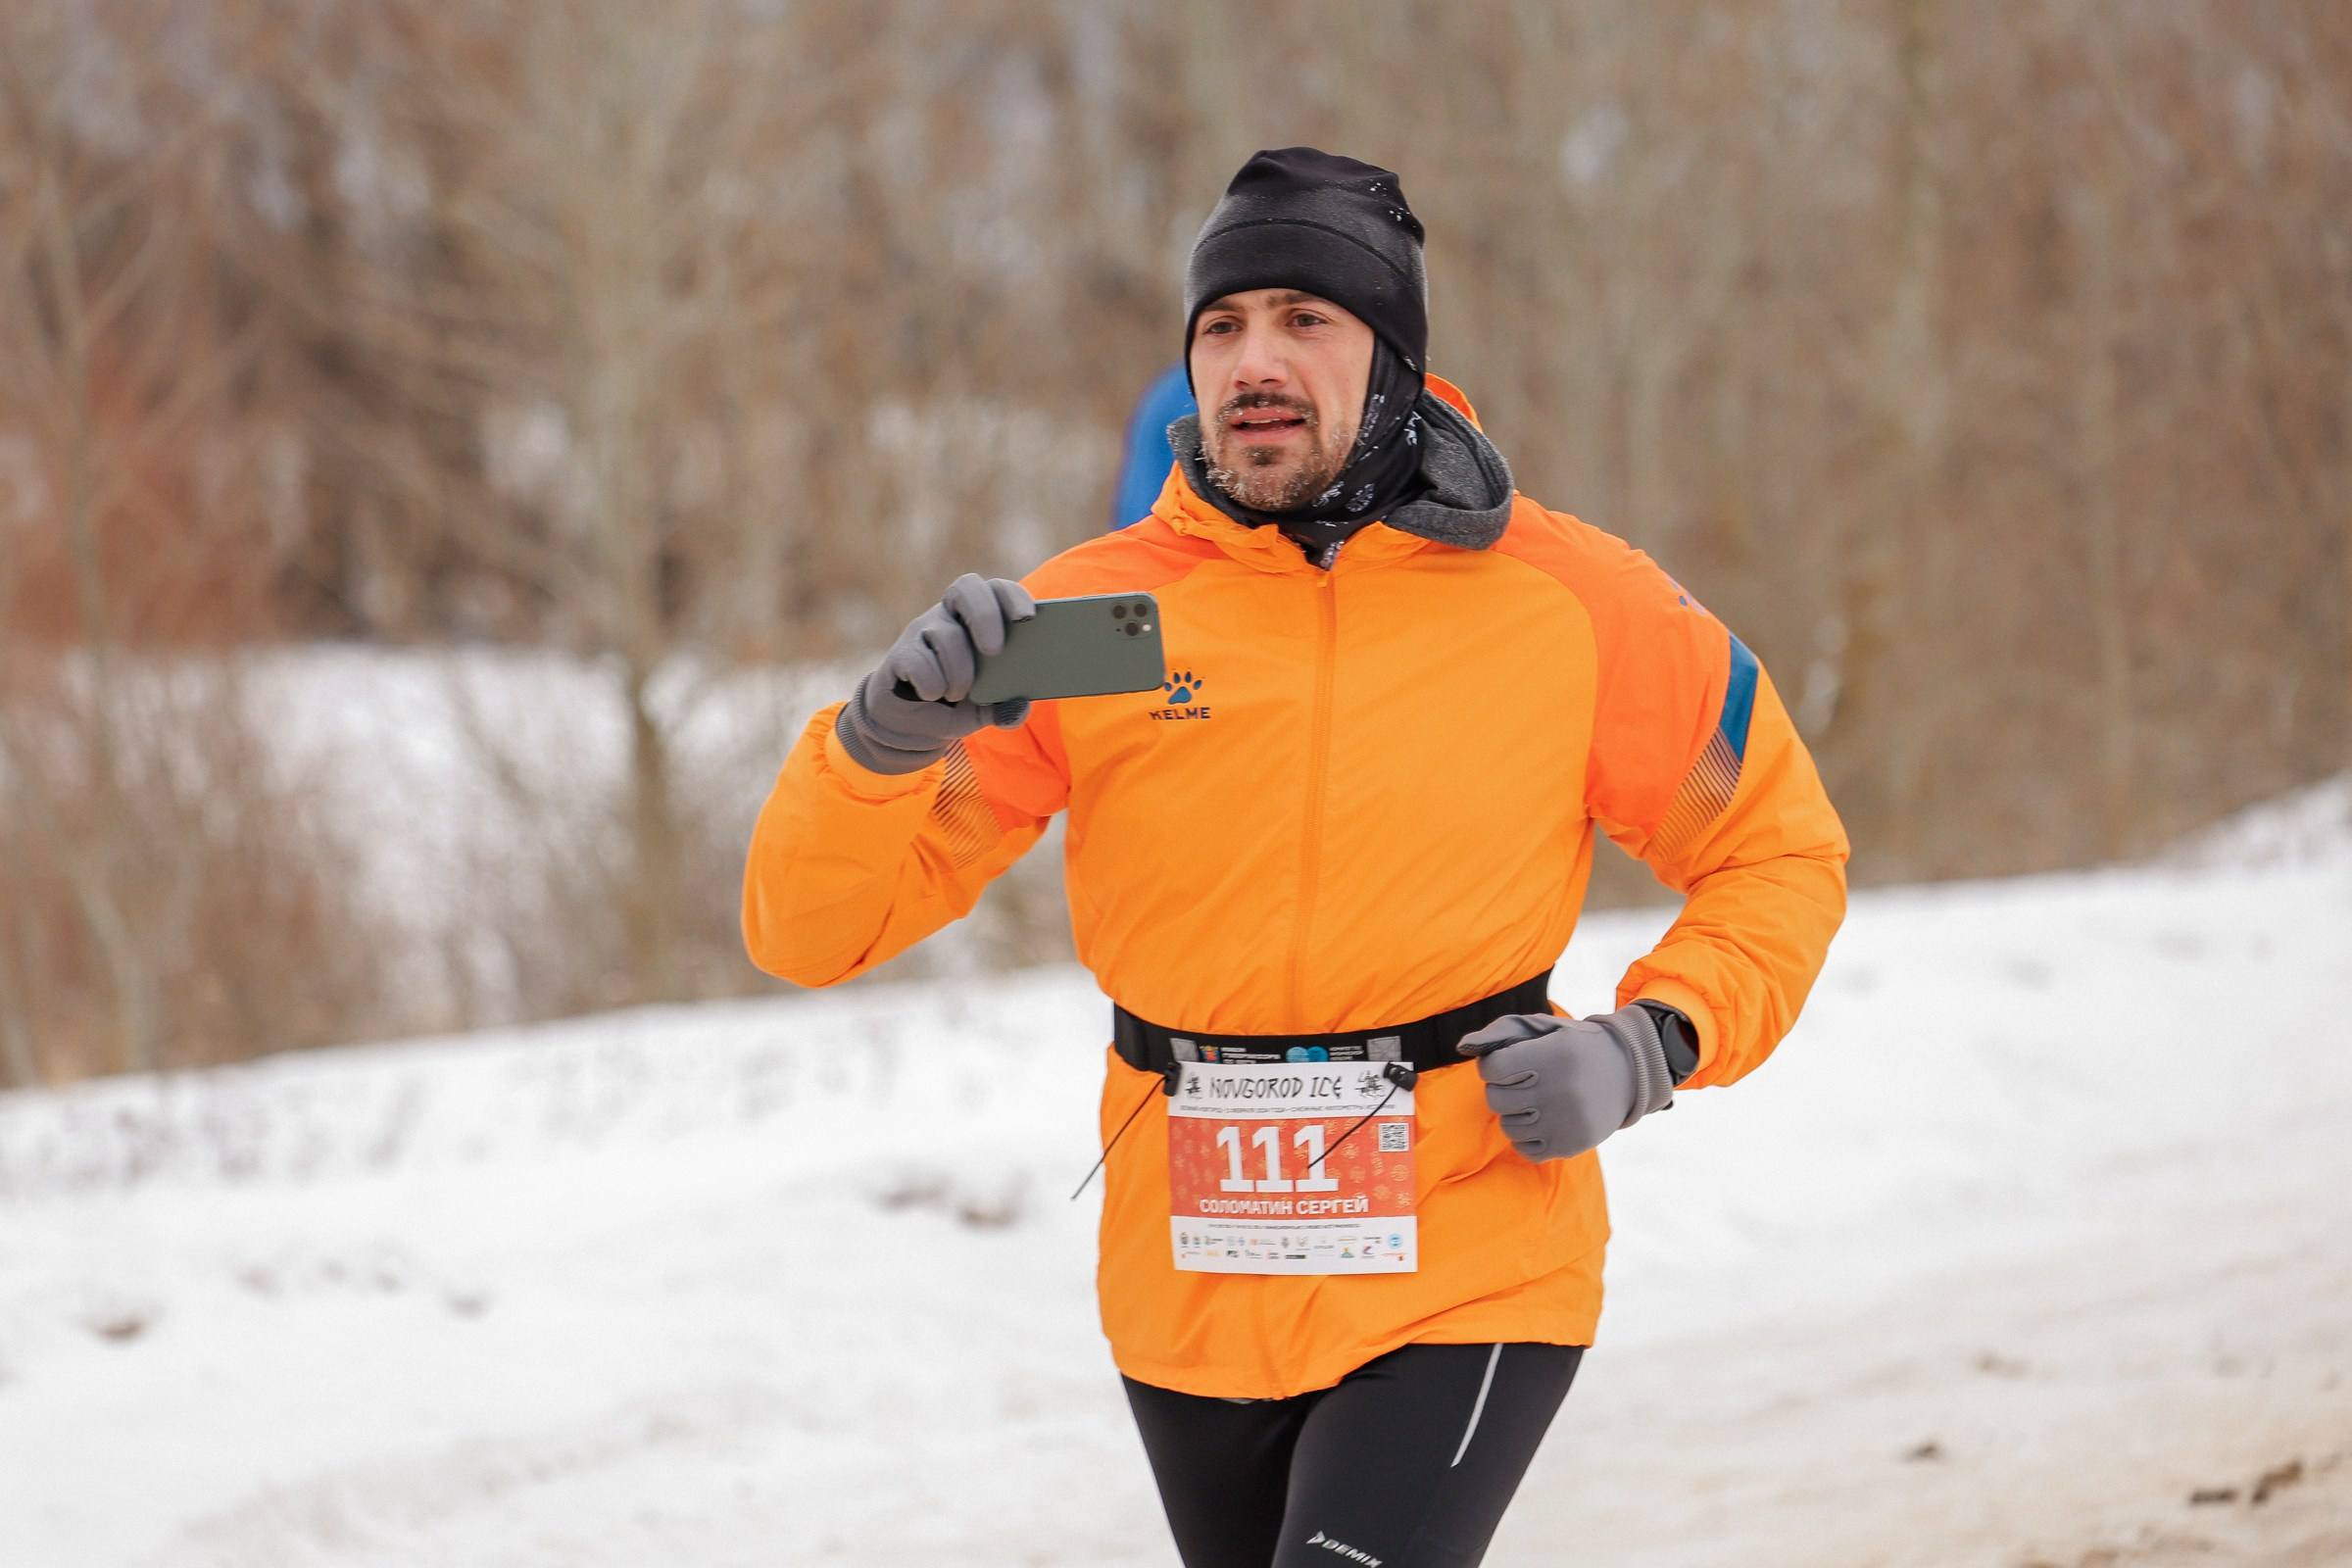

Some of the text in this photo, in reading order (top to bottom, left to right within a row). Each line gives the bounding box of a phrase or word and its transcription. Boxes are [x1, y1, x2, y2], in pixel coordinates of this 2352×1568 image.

[1149, 707, 1211, 720] KELME
[1209, 1076, 1343, 1099] NOVGOROD ICE
[1216, 1125, 1339, 1193] 111
[1199, 1195, 1369, 1215] СОЛОМАТИН СЕРГЕЙ
[1321, 1539, 1384, 1568] DEMIX
